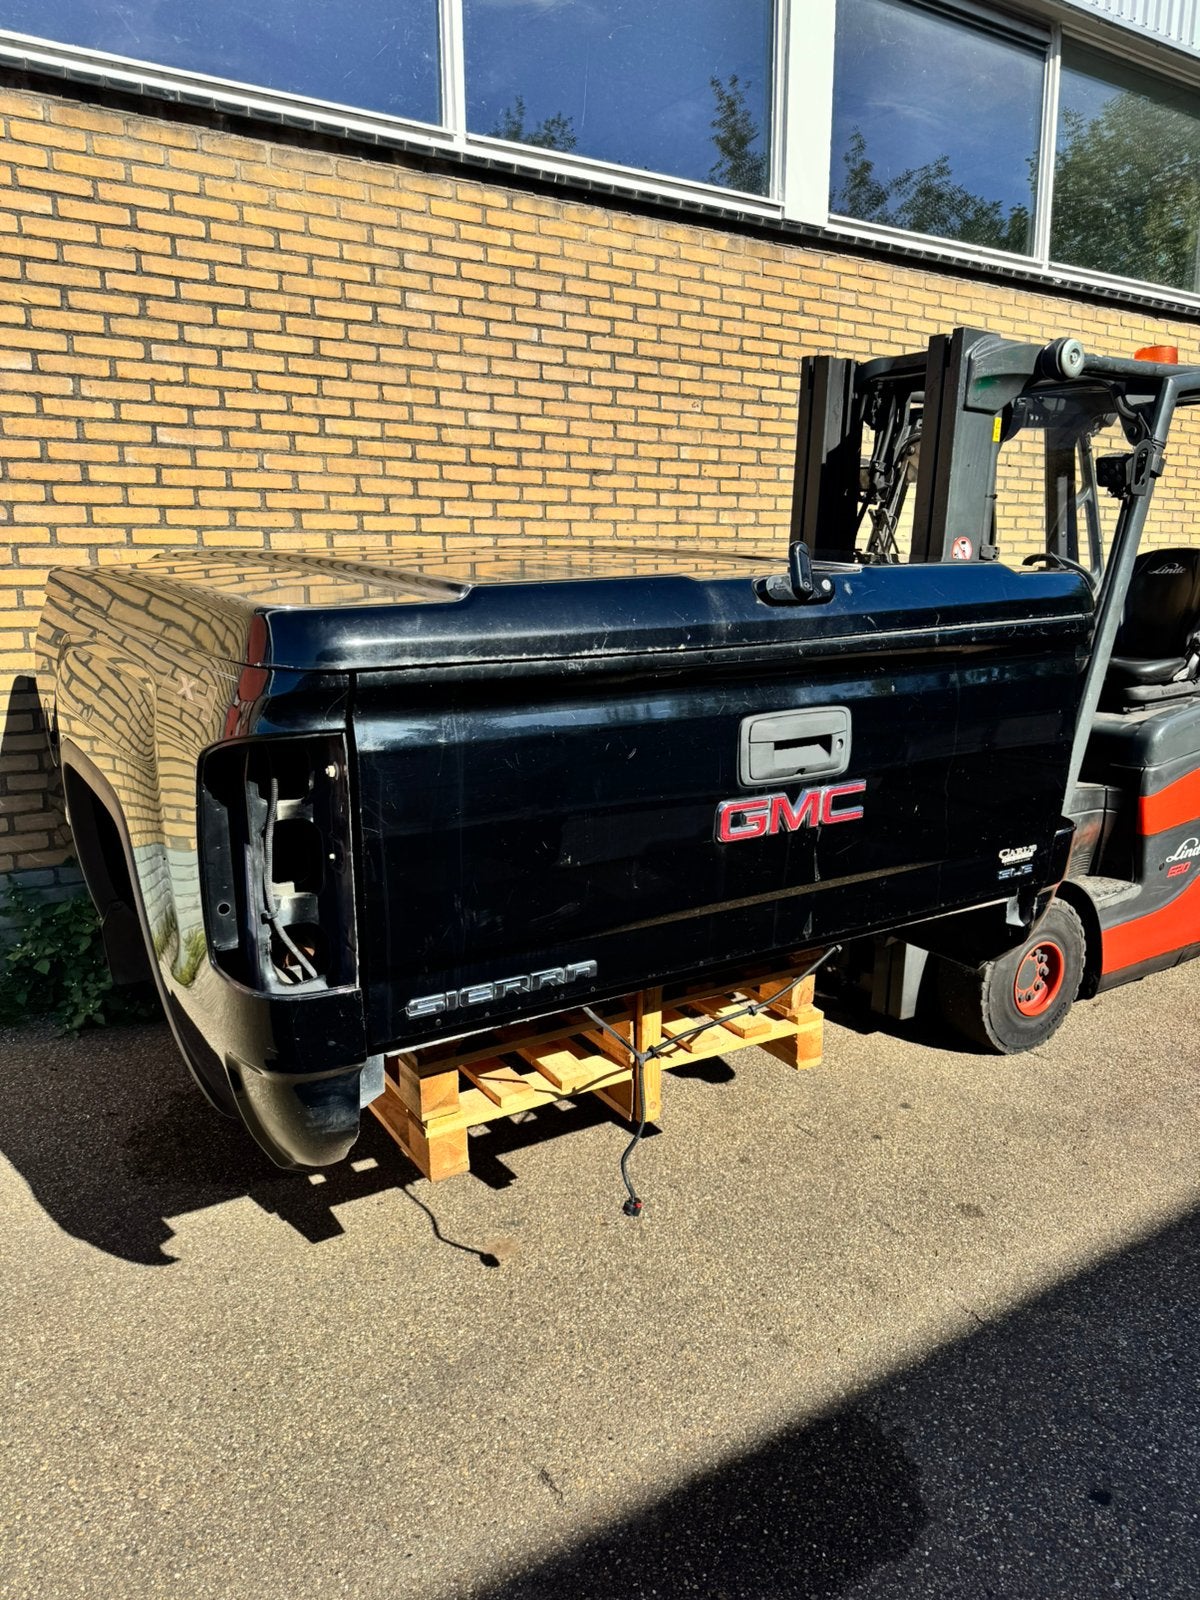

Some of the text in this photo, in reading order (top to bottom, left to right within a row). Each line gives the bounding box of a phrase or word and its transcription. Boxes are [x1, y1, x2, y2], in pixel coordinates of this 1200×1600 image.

[1147, 562, 1186, 574] Linde
[714, 779, 867, 843] GMC
[405, 959, 598, 1020] SIERRA
